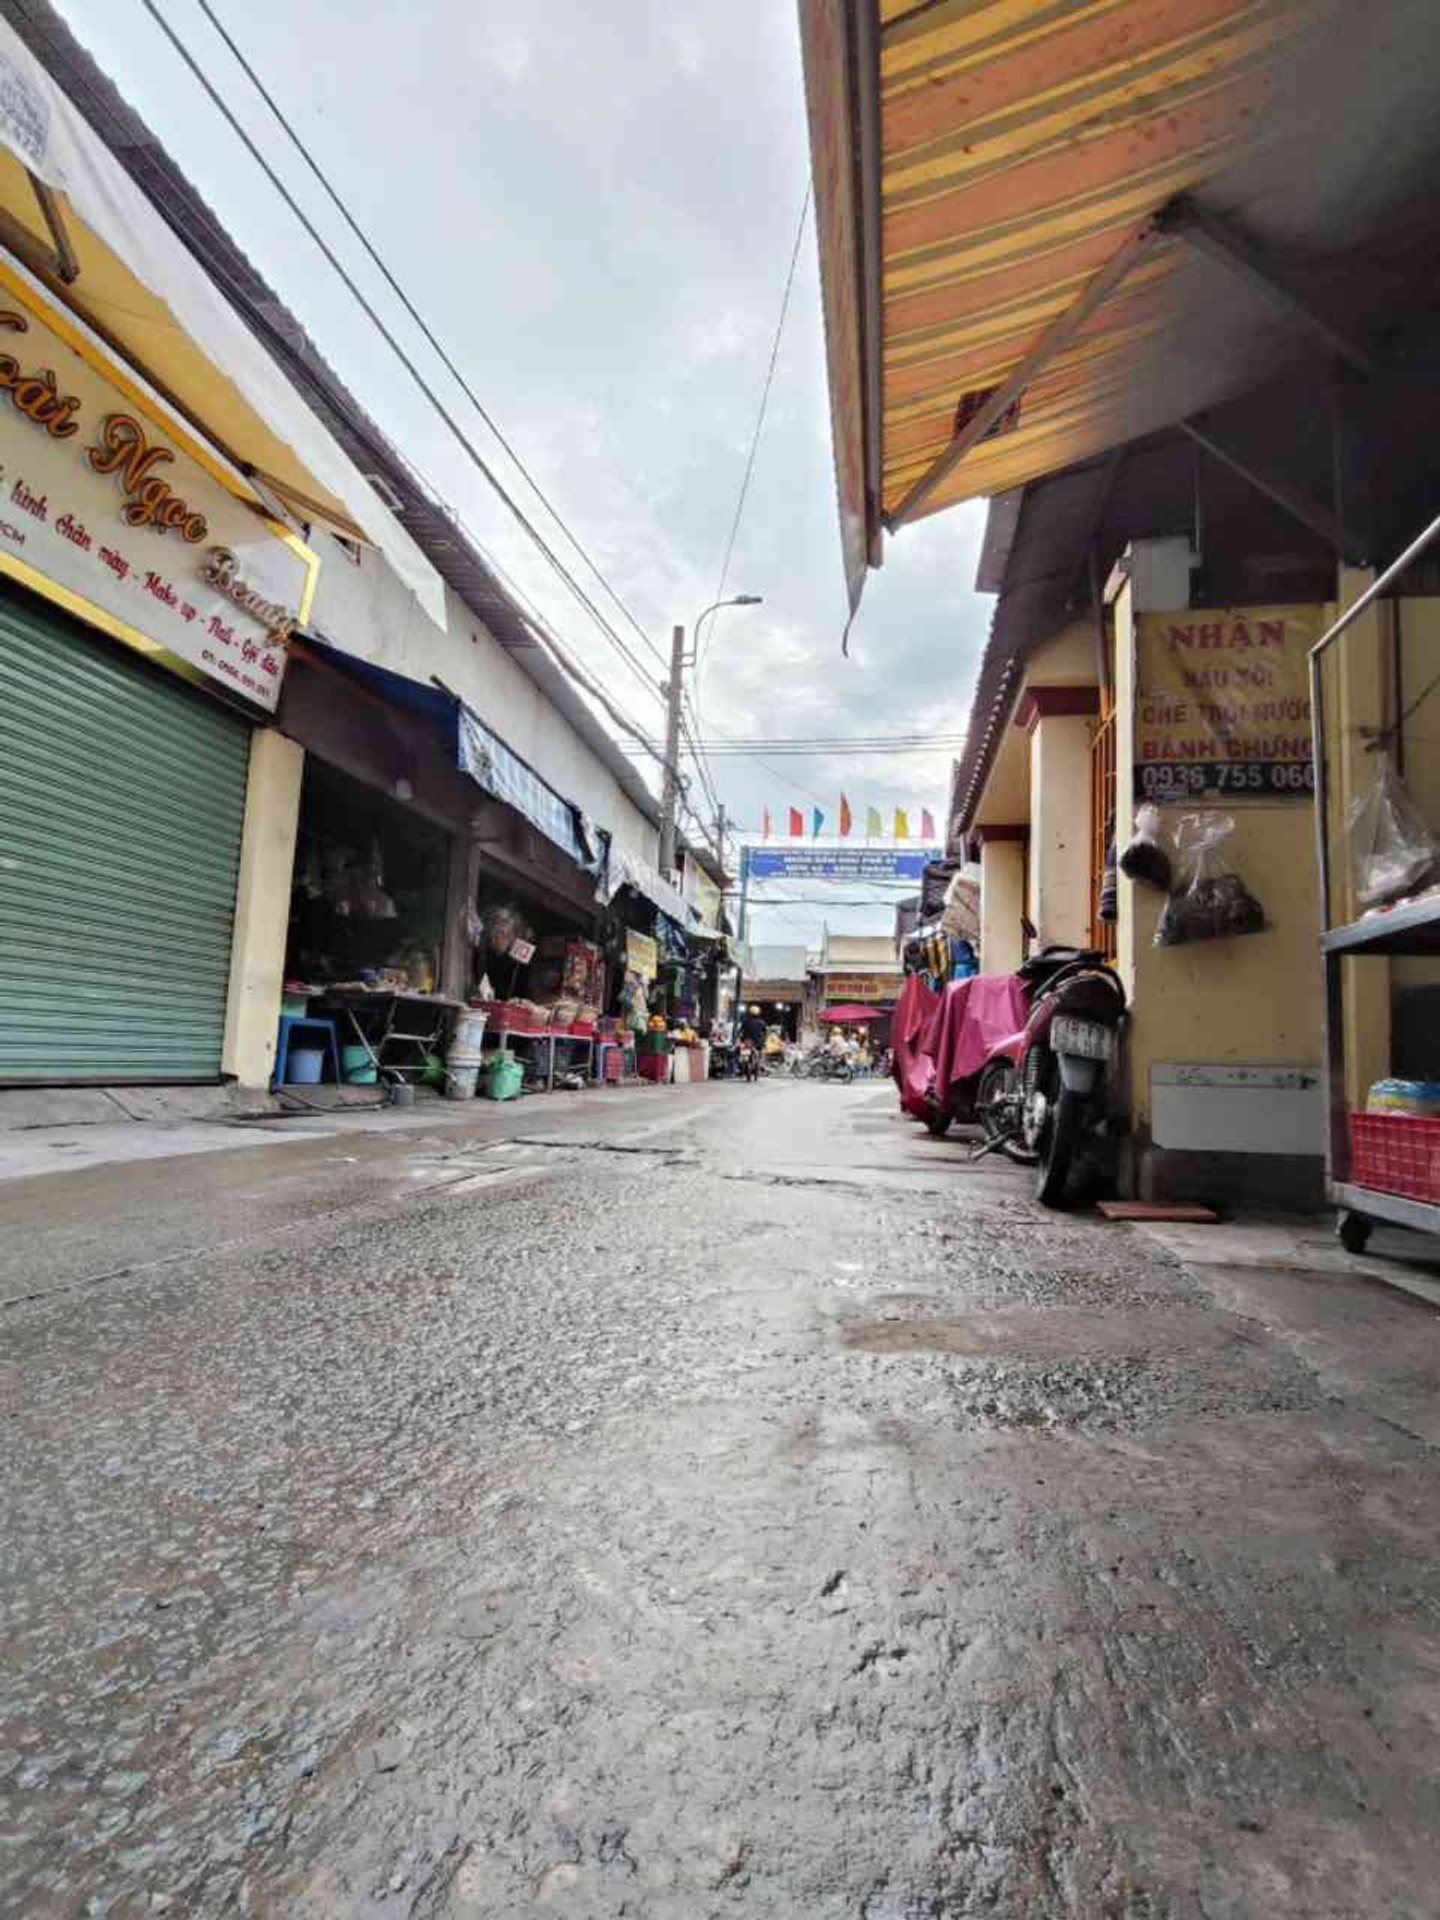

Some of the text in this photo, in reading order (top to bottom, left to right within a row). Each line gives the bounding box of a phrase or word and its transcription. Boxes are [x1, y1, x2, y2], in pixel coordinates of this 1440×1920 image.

[86, 413, 208, 544] Ngọc
[54, 513, 92, 551] chân
[1215, 764, 1263, 788] 755
